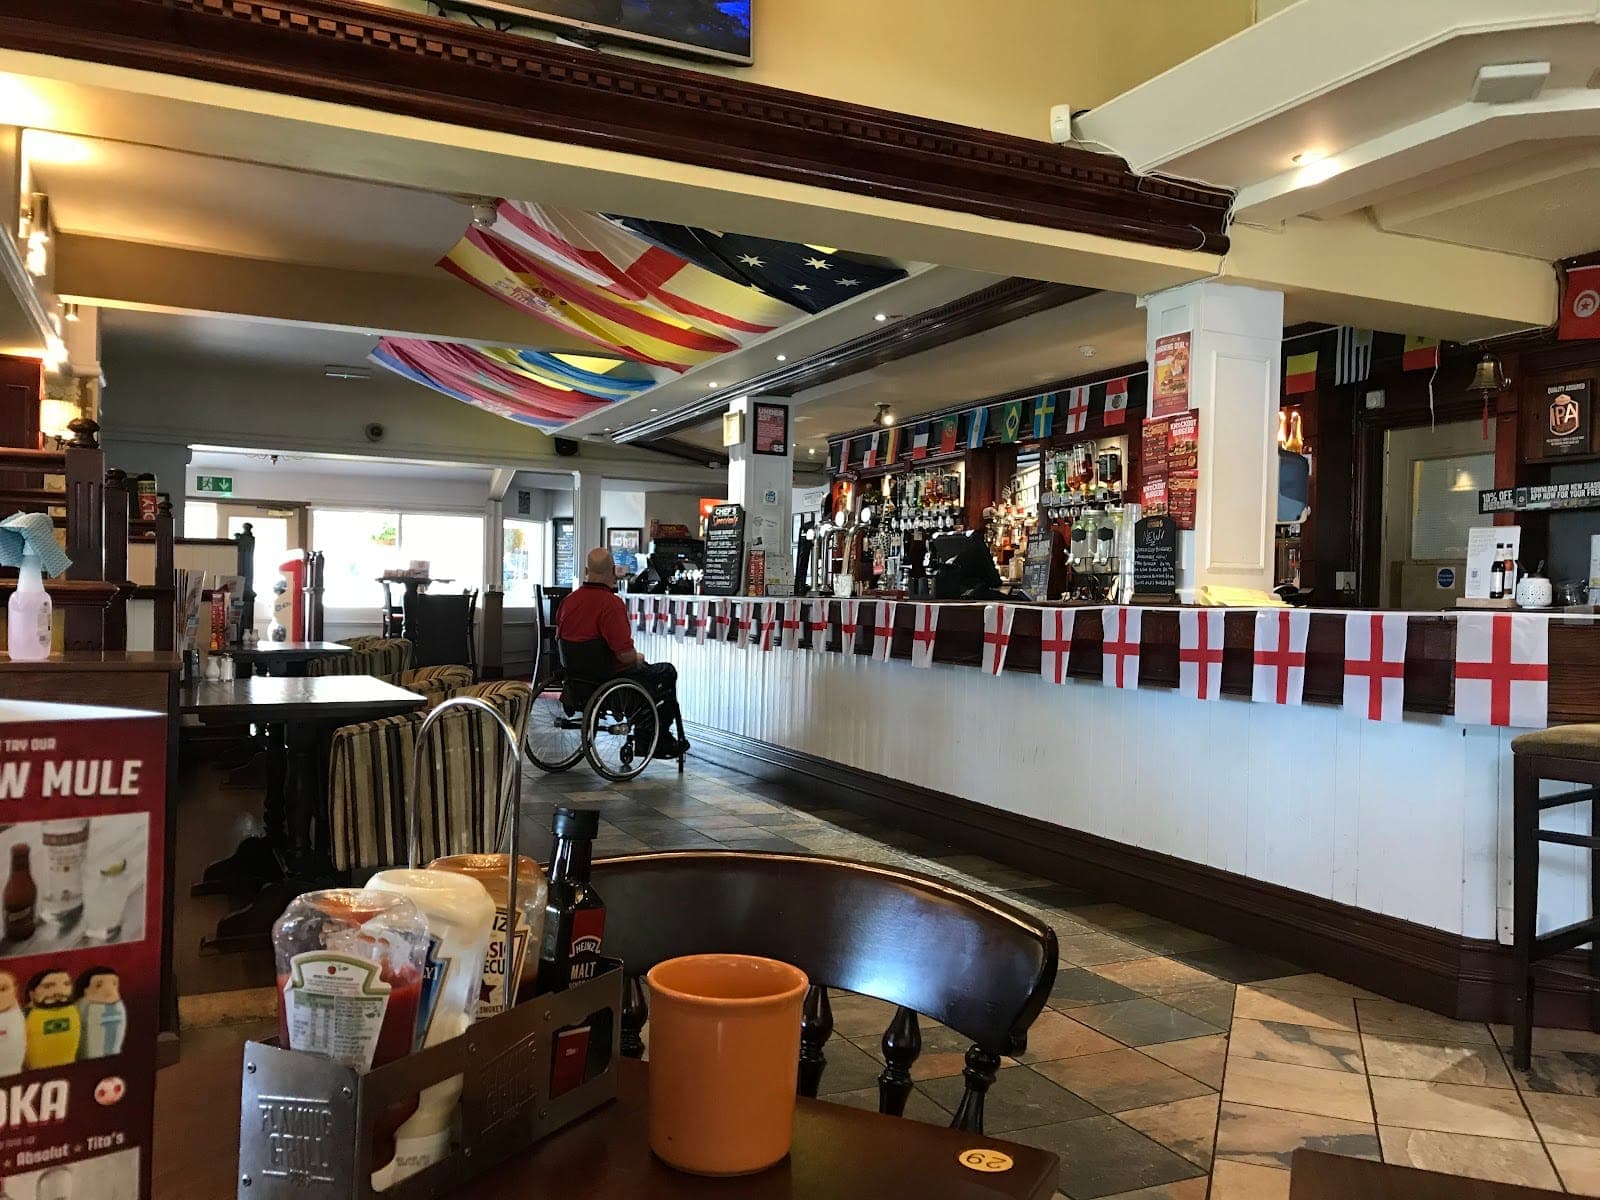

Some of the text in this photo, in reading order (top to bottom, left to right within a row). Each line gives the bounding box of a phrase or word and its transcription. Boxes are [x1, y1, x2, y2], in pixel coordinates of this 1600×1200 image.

[1550, 403, 1577, 426] IPA
[1498, 490, 1513, 500] OFF
[4, 738, 57, 752] TRY OUR
[42, 759, 144, 797] MULE
[575, 941, 596, 954] HEINZ
[570, 961, 597, 981] MALT
[16, 1131, 125, 1167] Absolut Tito's
